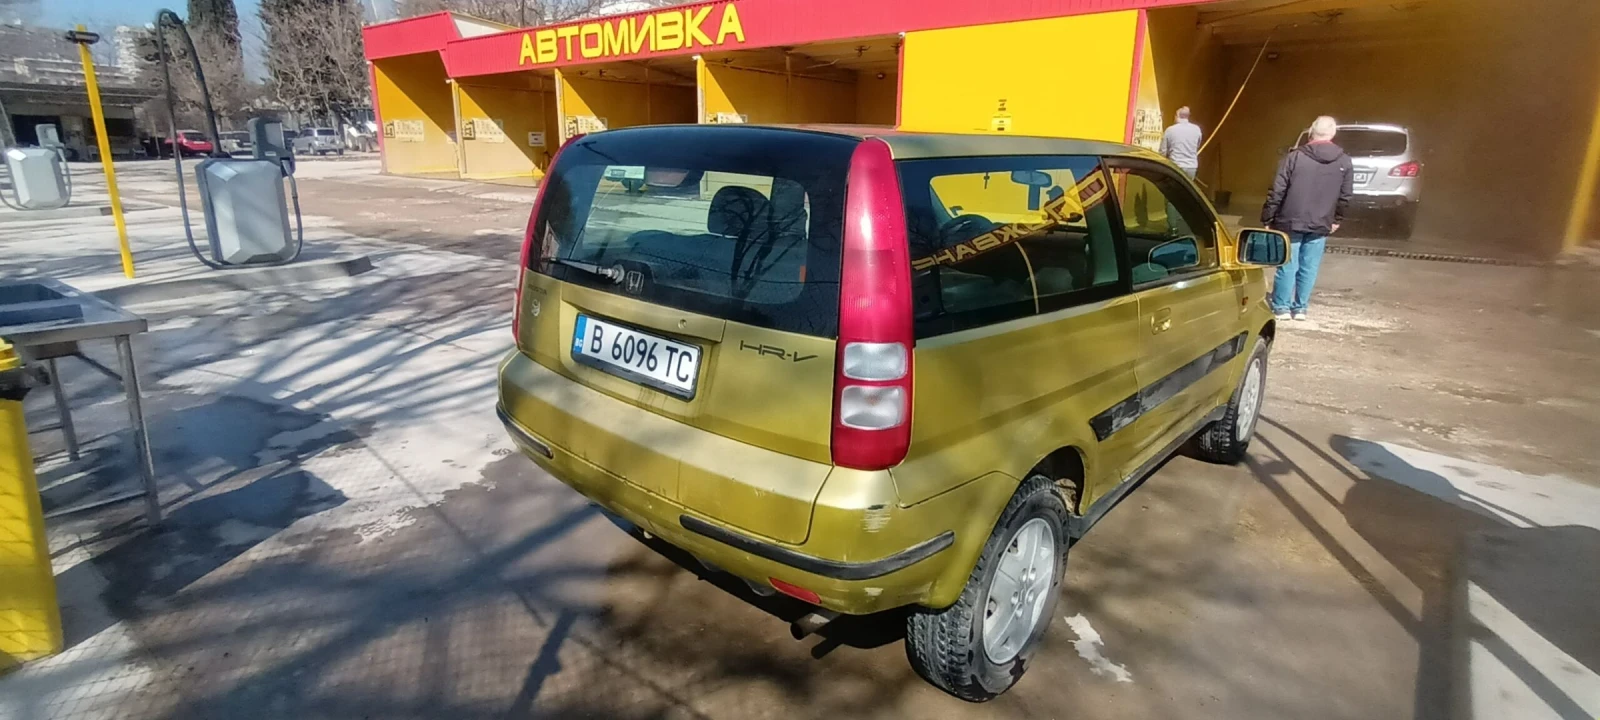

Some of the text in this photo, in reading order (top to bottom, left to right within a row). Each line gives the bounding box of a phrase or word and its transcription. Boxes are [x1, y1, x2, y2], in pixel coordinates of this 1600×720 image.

[519, 3, 745, 66] АВТОМИВКА
[590, 324, 693, 382] B 6096 TC
[740, 339, 819, 362] HR-V
